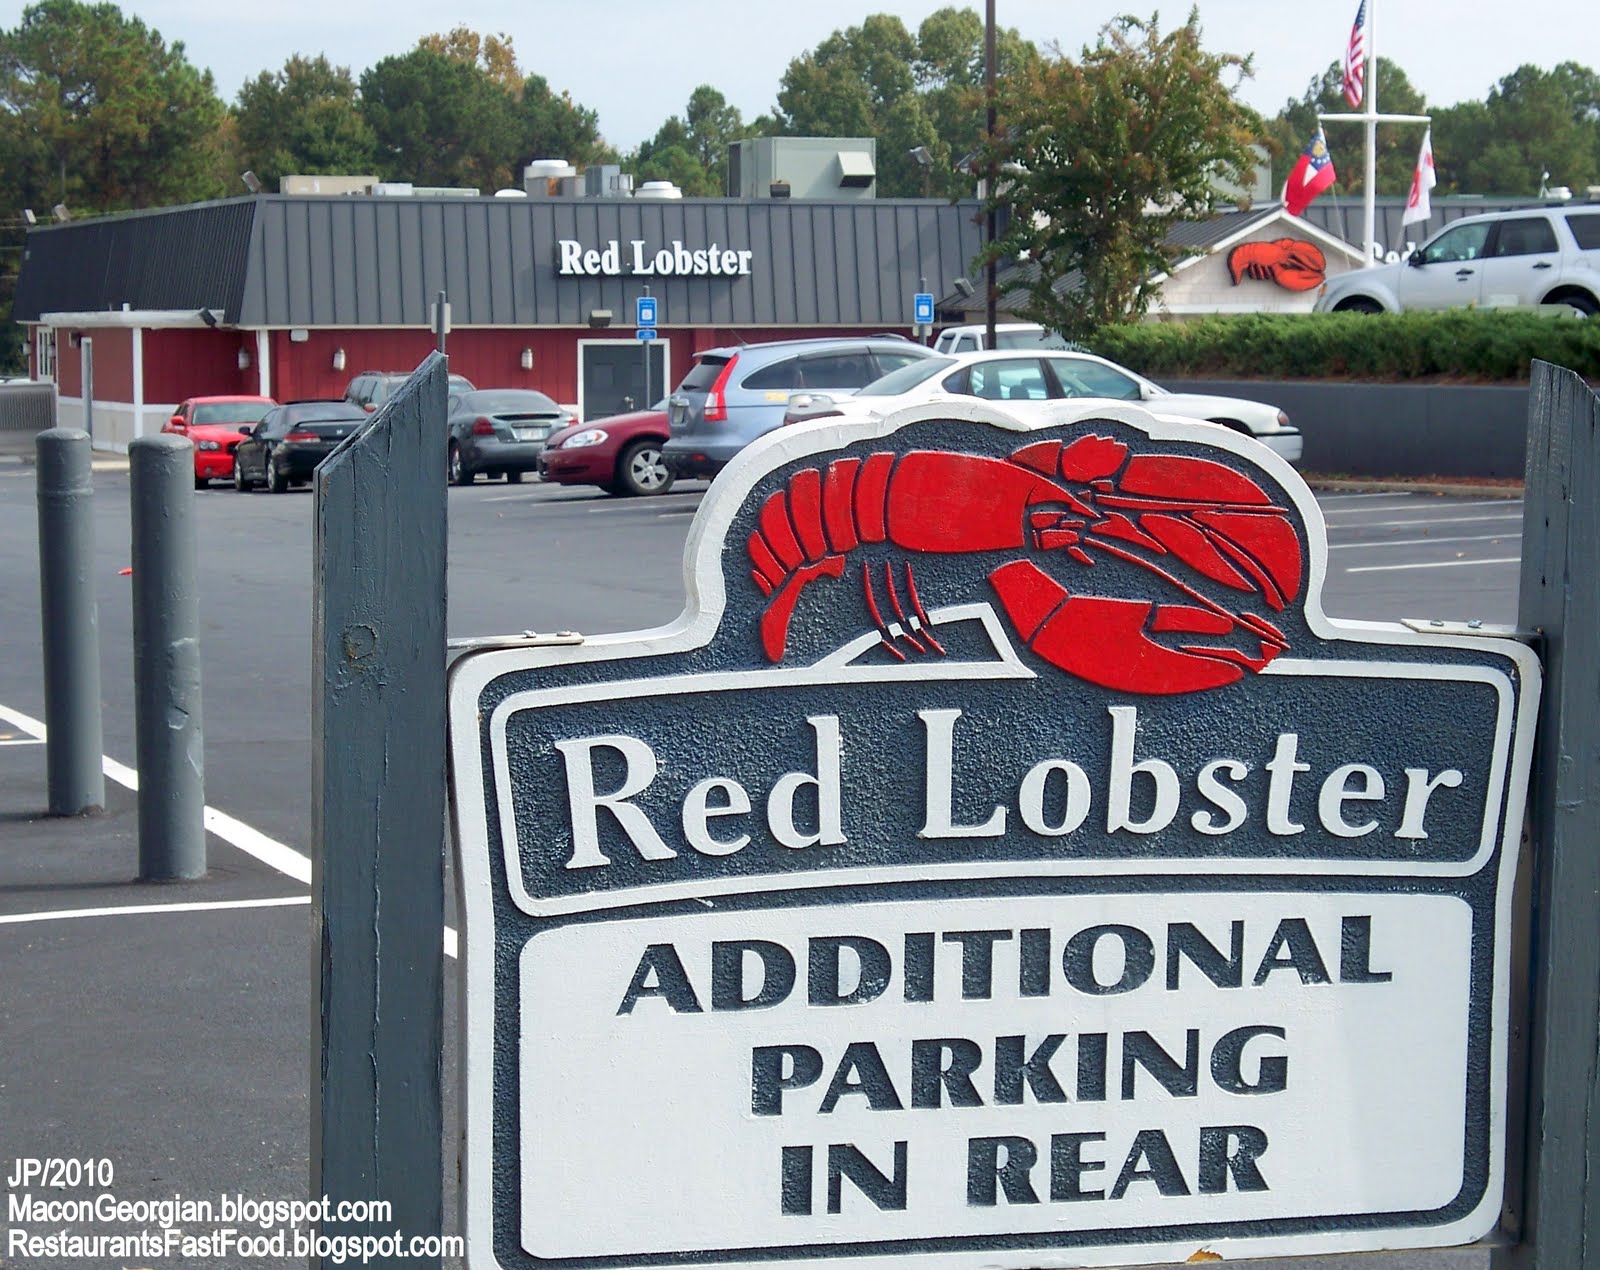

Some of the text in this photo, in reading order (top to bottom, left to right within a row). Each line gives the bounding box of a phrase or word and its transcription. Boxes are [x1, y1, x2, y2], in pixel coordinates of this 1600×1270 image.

[559, 240, 752, 275] Red Lobster
[554, 705, 1464, 870] Red Lobster
[616, 915, 1393, 1016] ADDITIONAL
[750, 1025, 1289, 1117] PARKING
[780, 1125, 1269, 1216] IN REAR
